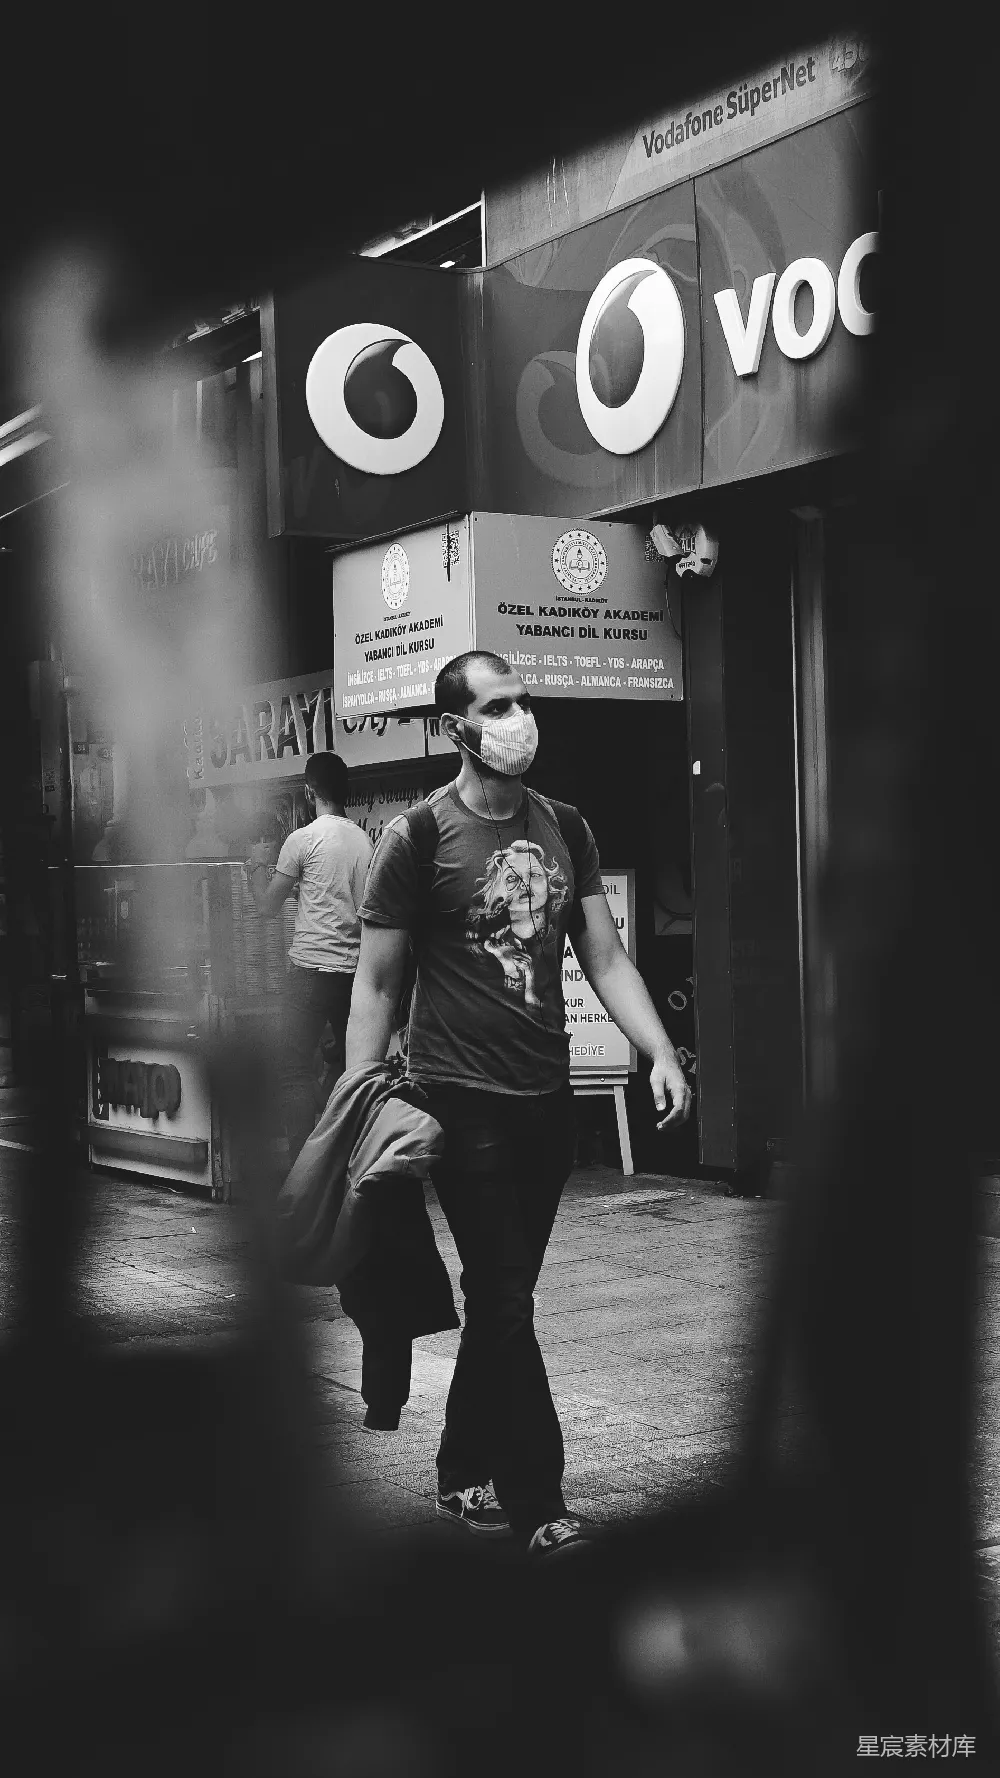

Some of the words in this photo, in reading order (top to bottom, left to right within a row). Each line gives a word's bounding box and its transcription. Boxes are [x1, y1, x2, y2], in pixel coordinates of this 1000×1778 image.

[642, 104, 724, 159] Vodafone
[726, 56, 816, 120] SüperNet
[498, 602, 535, 616] ÖZEL
[538, 606, 600, 619] KADIKÖY
[603, 609, 664, 622] AKADEMİ
[354, 632, 374, 645] ÖZEL
[374, 624, 407, 641] KADIKÖY
[408, 614, 444, 634] AKADEMİ
[516, 624, 575, 638] YABANCI
[578, 624, 600, 639] DİL
[603, 628, 648, 641] KURSU
[364, 646, 394, 663] YABANCI
[396, 641, 408, 657] DİL
[408, 637, 435, 654] KURSU
[494, 650, 537, 666] GİLİZCE
[543, 654, 569, 667] IELTS
[573, 655, 602, 669] TOEFL
[607, 657, 626, 669] YDS
[630, 658, 665, 673] ARAPÇA
[544, 674, 575, 689] RUSÇA
[580, 676, 622, 688] ALMANCA
[627, 676, 675, 689] FRANSIZCA
[565, 1013, 578, 1023] AN
[580, 1013, 615, 1023] HERKE
